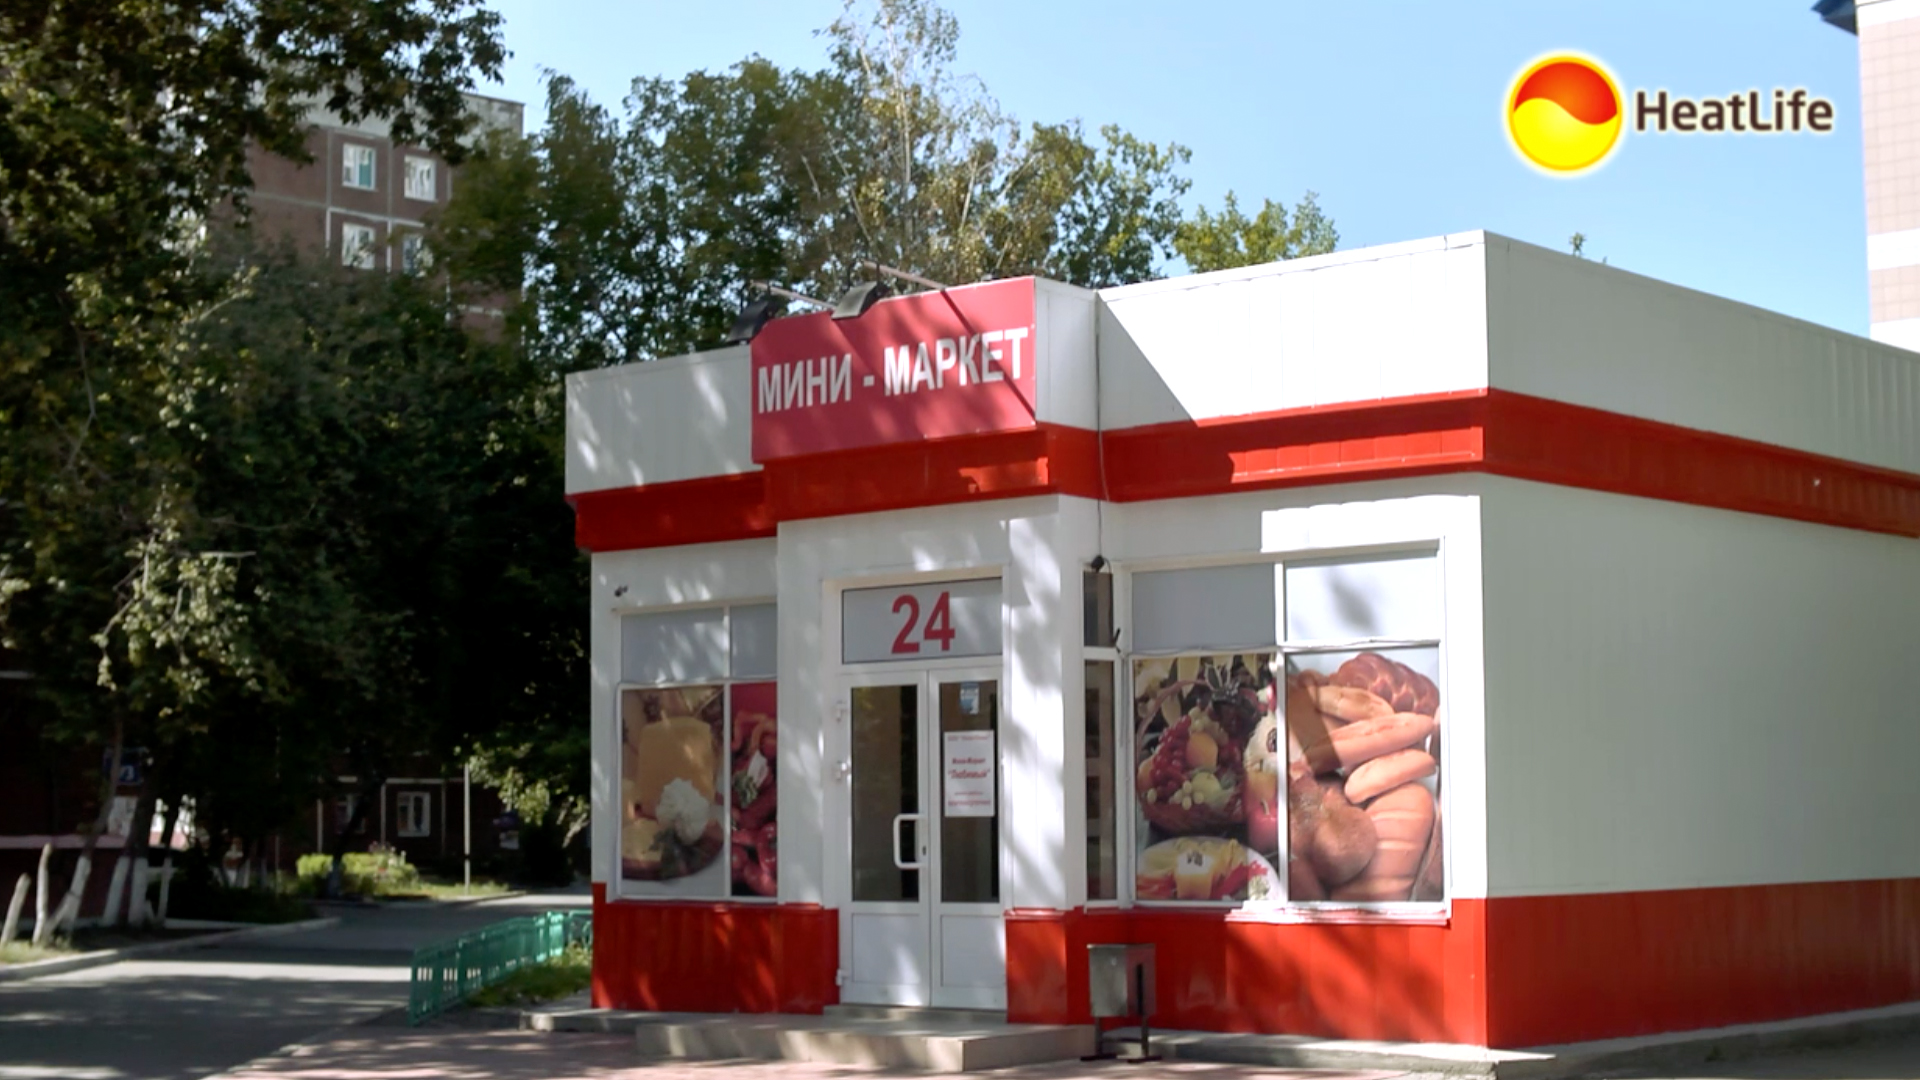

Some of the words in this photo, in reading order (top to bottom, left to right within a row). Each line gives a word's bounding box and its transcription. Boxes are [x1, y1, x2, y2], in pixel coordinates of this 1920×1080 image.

[758, 353, 852, 414] МИНИ
[883, 327, 1029, 397] МАРКЕТ
[891, 591, 956, 654] 24
